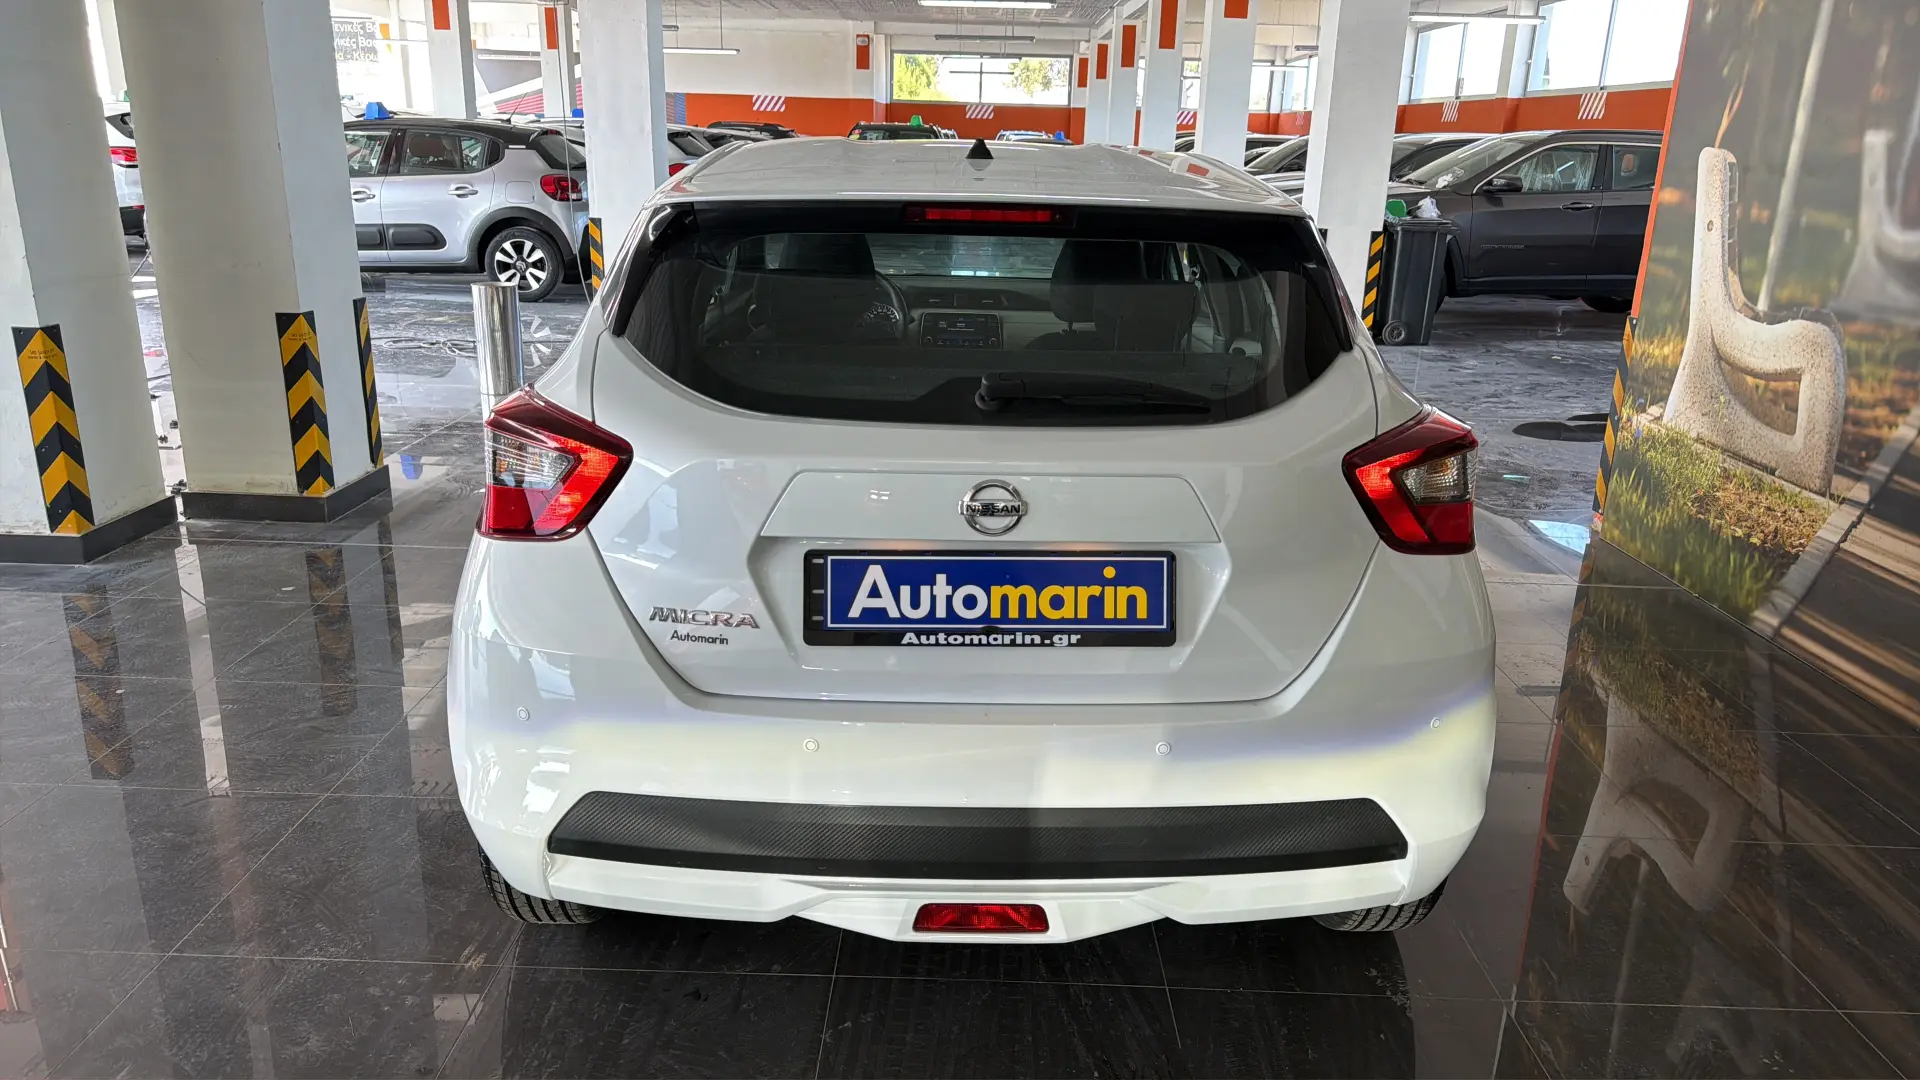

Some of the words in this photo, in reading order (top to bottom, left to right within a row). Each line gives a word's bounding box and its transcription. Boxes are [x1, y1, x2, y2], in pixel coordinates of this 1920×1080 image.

[966, 505, 1021, 514] NISSAN
[848, 564, 1148, 619] Automarin
[649, 606, 760, 629] MICRA
[670, 630, 729, 645] Automarin
[901, 632, 1082, 646] Automarin.gr
